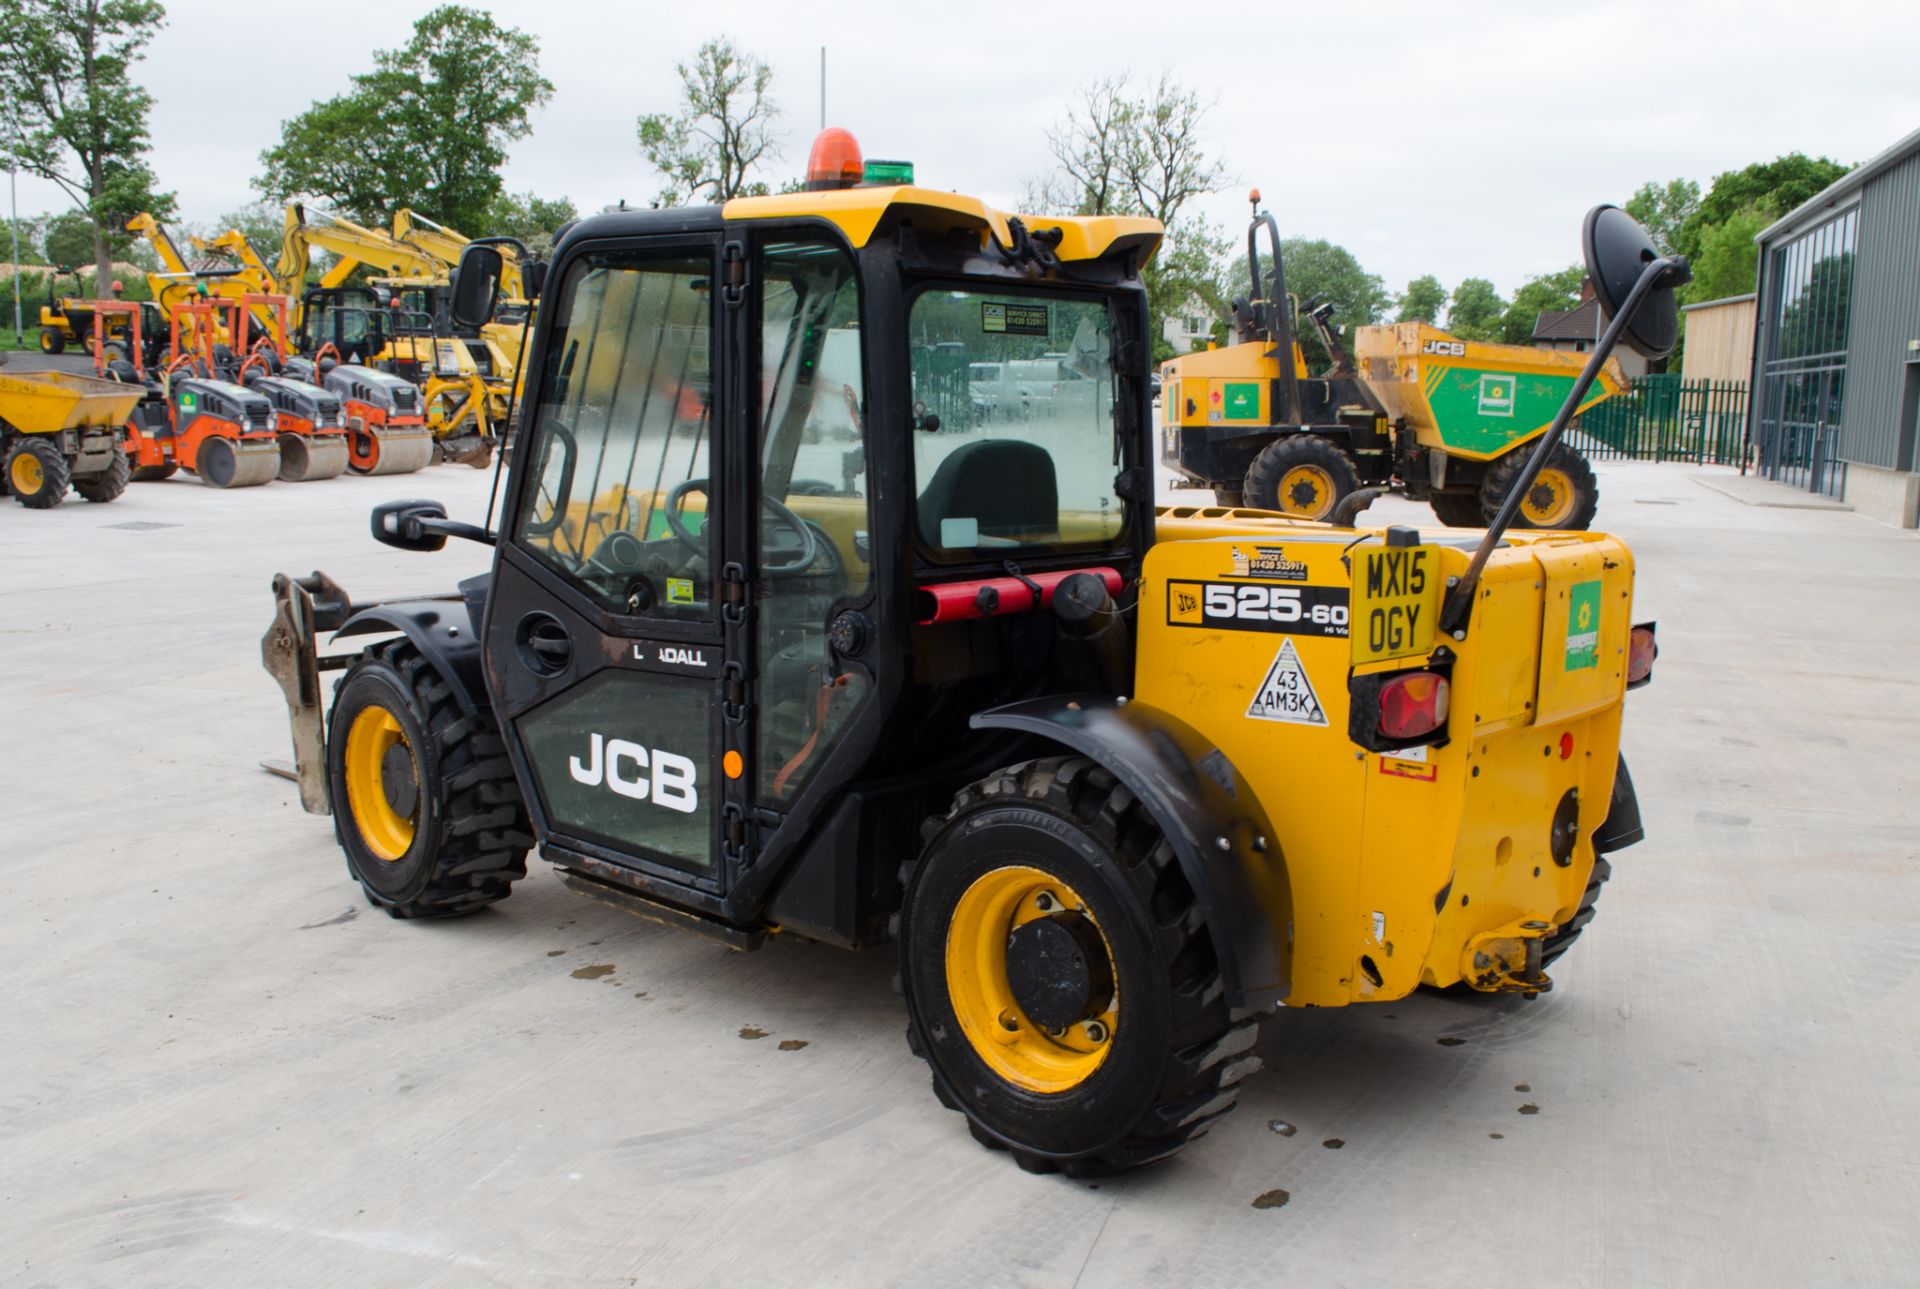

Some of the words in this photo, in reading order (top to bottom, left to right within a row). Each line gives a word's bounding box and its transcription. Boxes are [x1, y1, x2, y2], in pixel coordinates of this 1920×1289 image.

[986, 306, 1004, 317] JCB
[1423, 340, 1465, 357] JCB
[1250, 560, 1275, 569] 01420
[1276, 561, 1305, 571] 525917
[1367, 551, 1427, 599] MX15
[1178, 594, 1198, 612] JCB
[1204, 584, 1349, 626] 525-60
[1324, 626, 1335, 634] Hi
[1369, 604, 1420, 652] OGY
[1277, 671, 1298, 690] 43
[1265, 690, 1310, 713] AM3K
[569, 733, 698, 814] JCB
